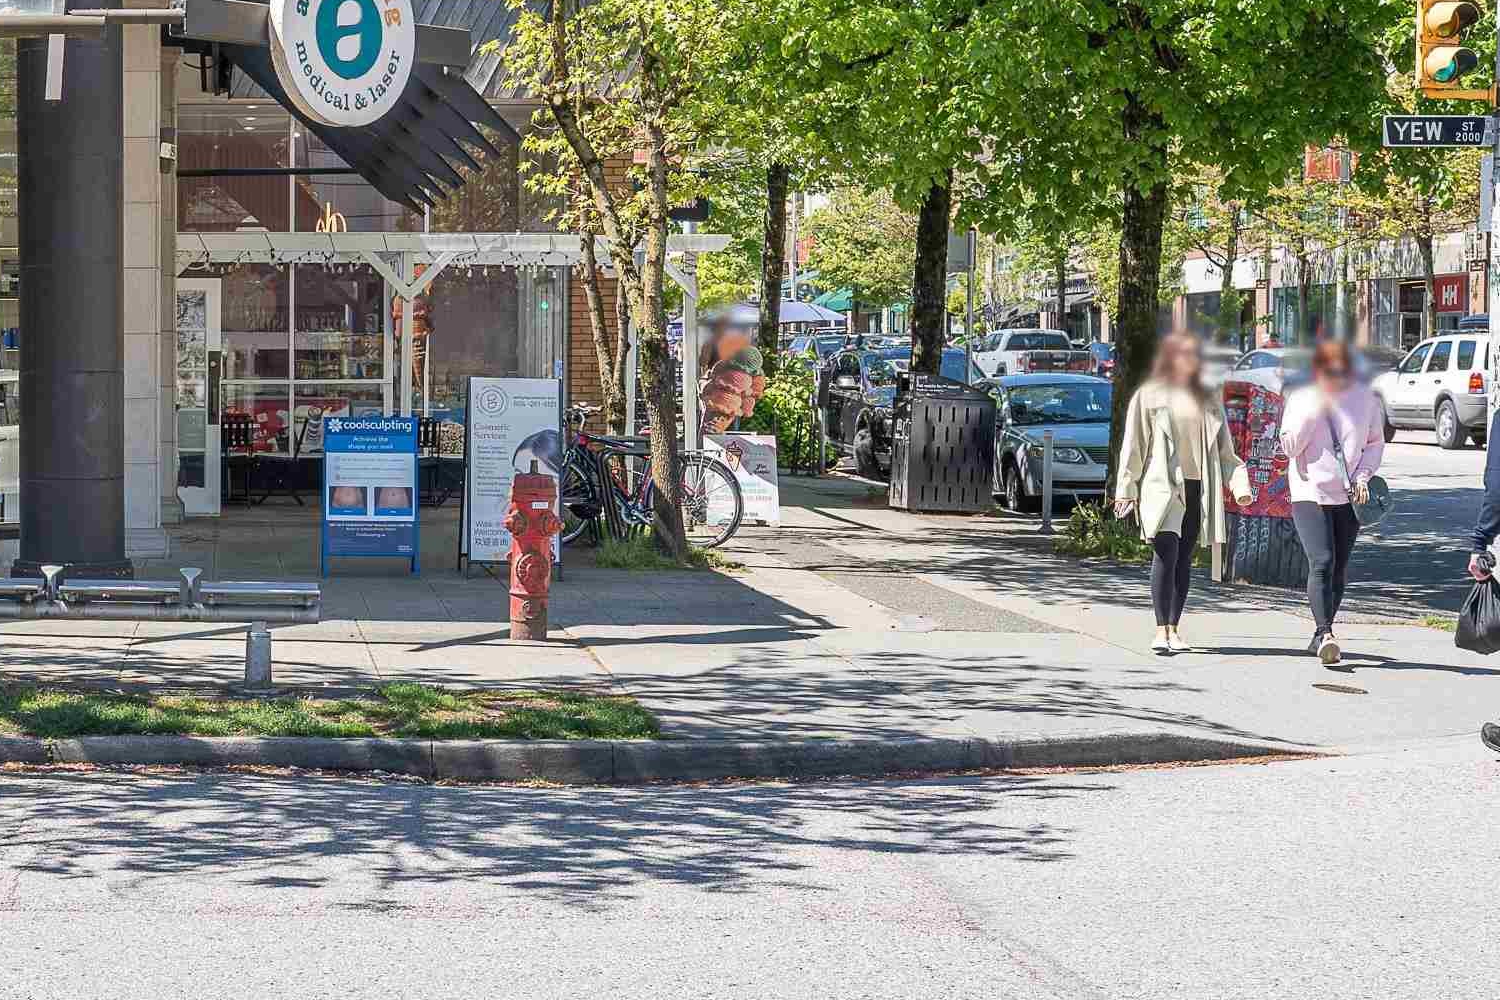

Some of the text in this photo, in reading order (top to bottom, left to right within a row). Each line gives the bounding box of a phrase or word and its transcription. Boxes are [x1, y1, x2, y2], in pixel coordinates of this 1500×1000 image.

[295, 40, 401, 111] medical & laser
[1394, 121, 1475, 141] YEW ST
[1455, 132, 1481, 142] 2000
[343, 419, 412, 432] coolsculpting
